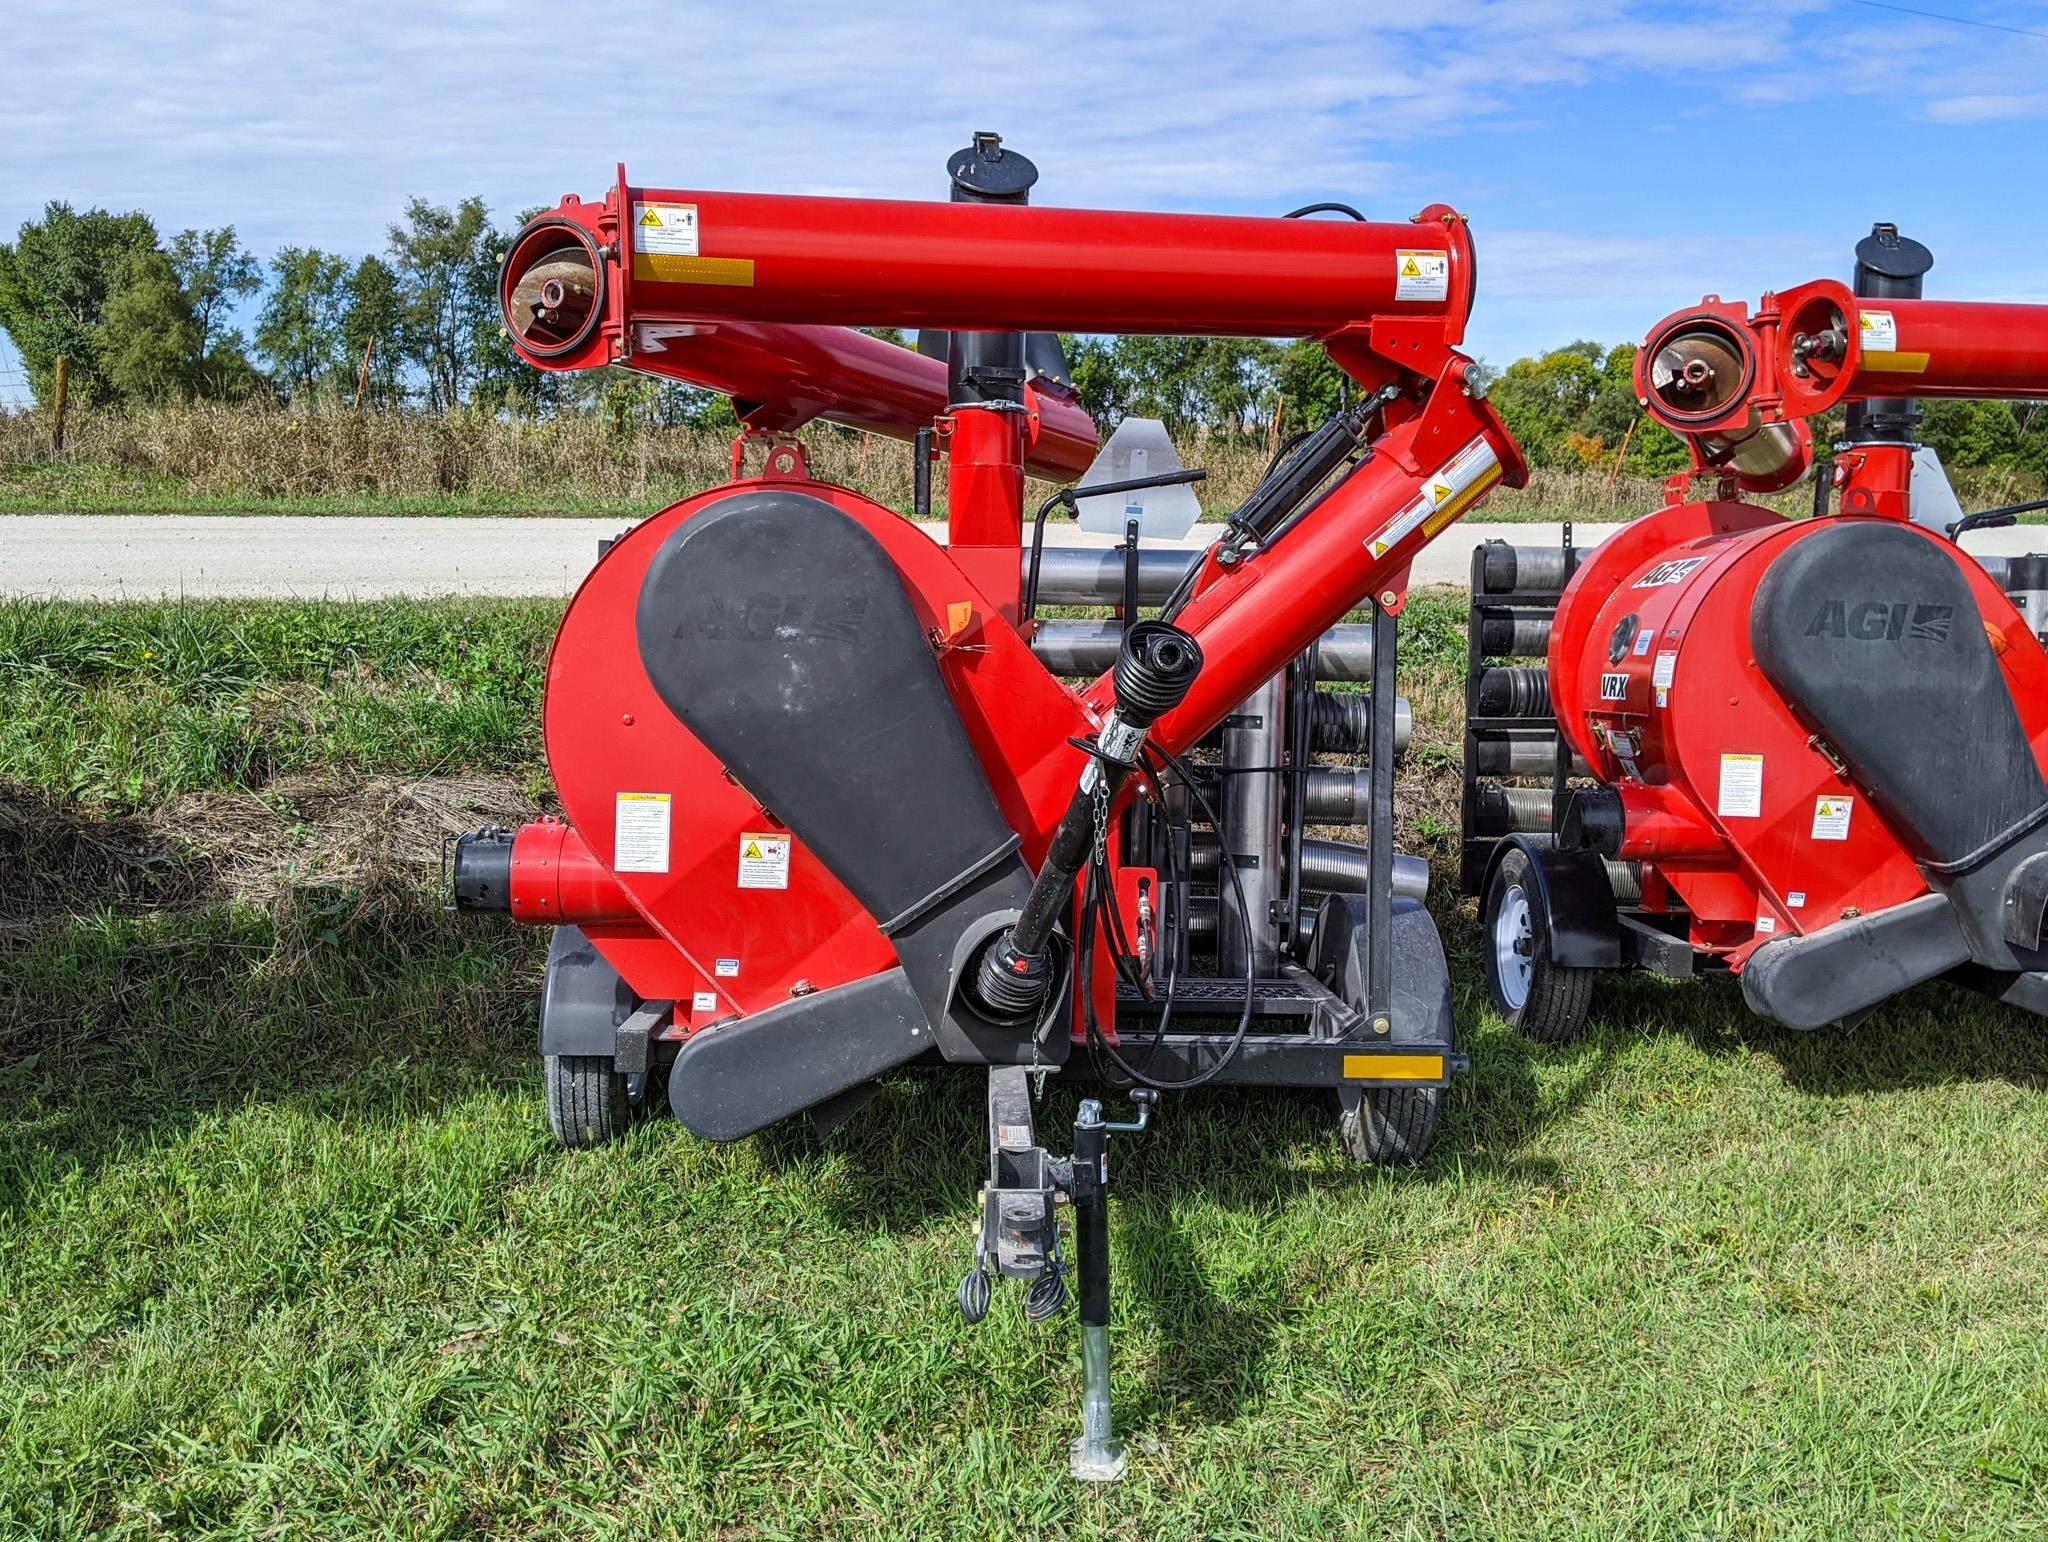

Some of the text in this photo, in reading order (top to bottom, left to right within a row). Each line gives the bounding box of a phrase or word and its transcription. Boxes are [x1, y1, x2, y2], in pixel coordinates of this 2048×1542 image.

[1636, 561, 1689, 585] AGI
[1803, 600, 1908, 640] AGI
[1602, 676, 1628, 698] VRX
